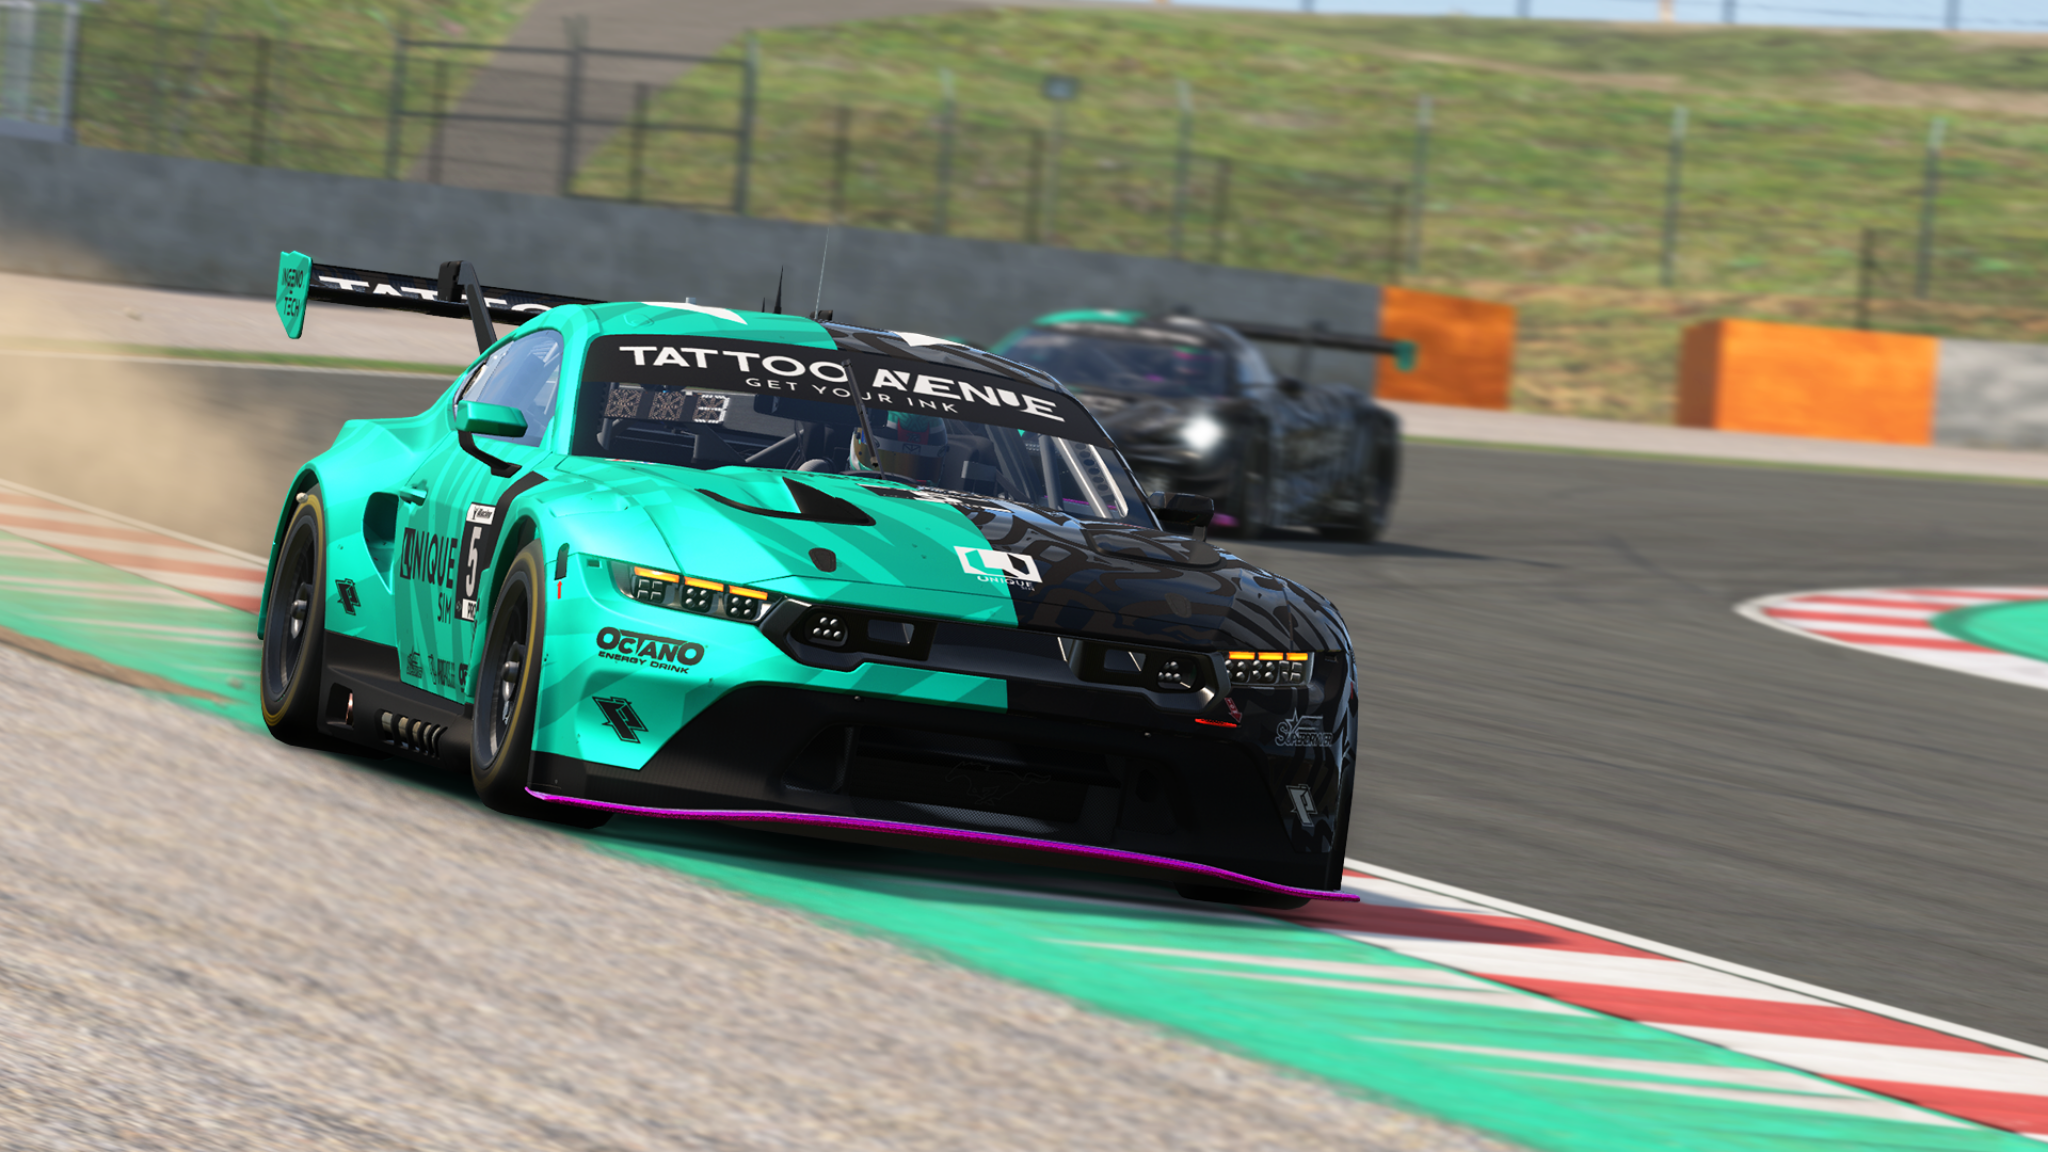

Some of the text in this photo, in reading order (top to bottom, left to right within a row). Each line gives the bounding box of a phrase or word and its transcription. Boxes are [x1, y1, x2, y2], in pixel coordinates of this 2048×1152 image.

[619, 346, 1066, 423] TATTOO AVENUE
[745, 377, 959, 414] GET YOUR INK
[400, 527, 458, 589] UNIQUE
[465, 526, 482, 597] 5
[977, 575, 1034, 588] UNIQUE
[437, 592, 451, 624] SIM
[598, 650, 689, 675] ENERGY DRINK
